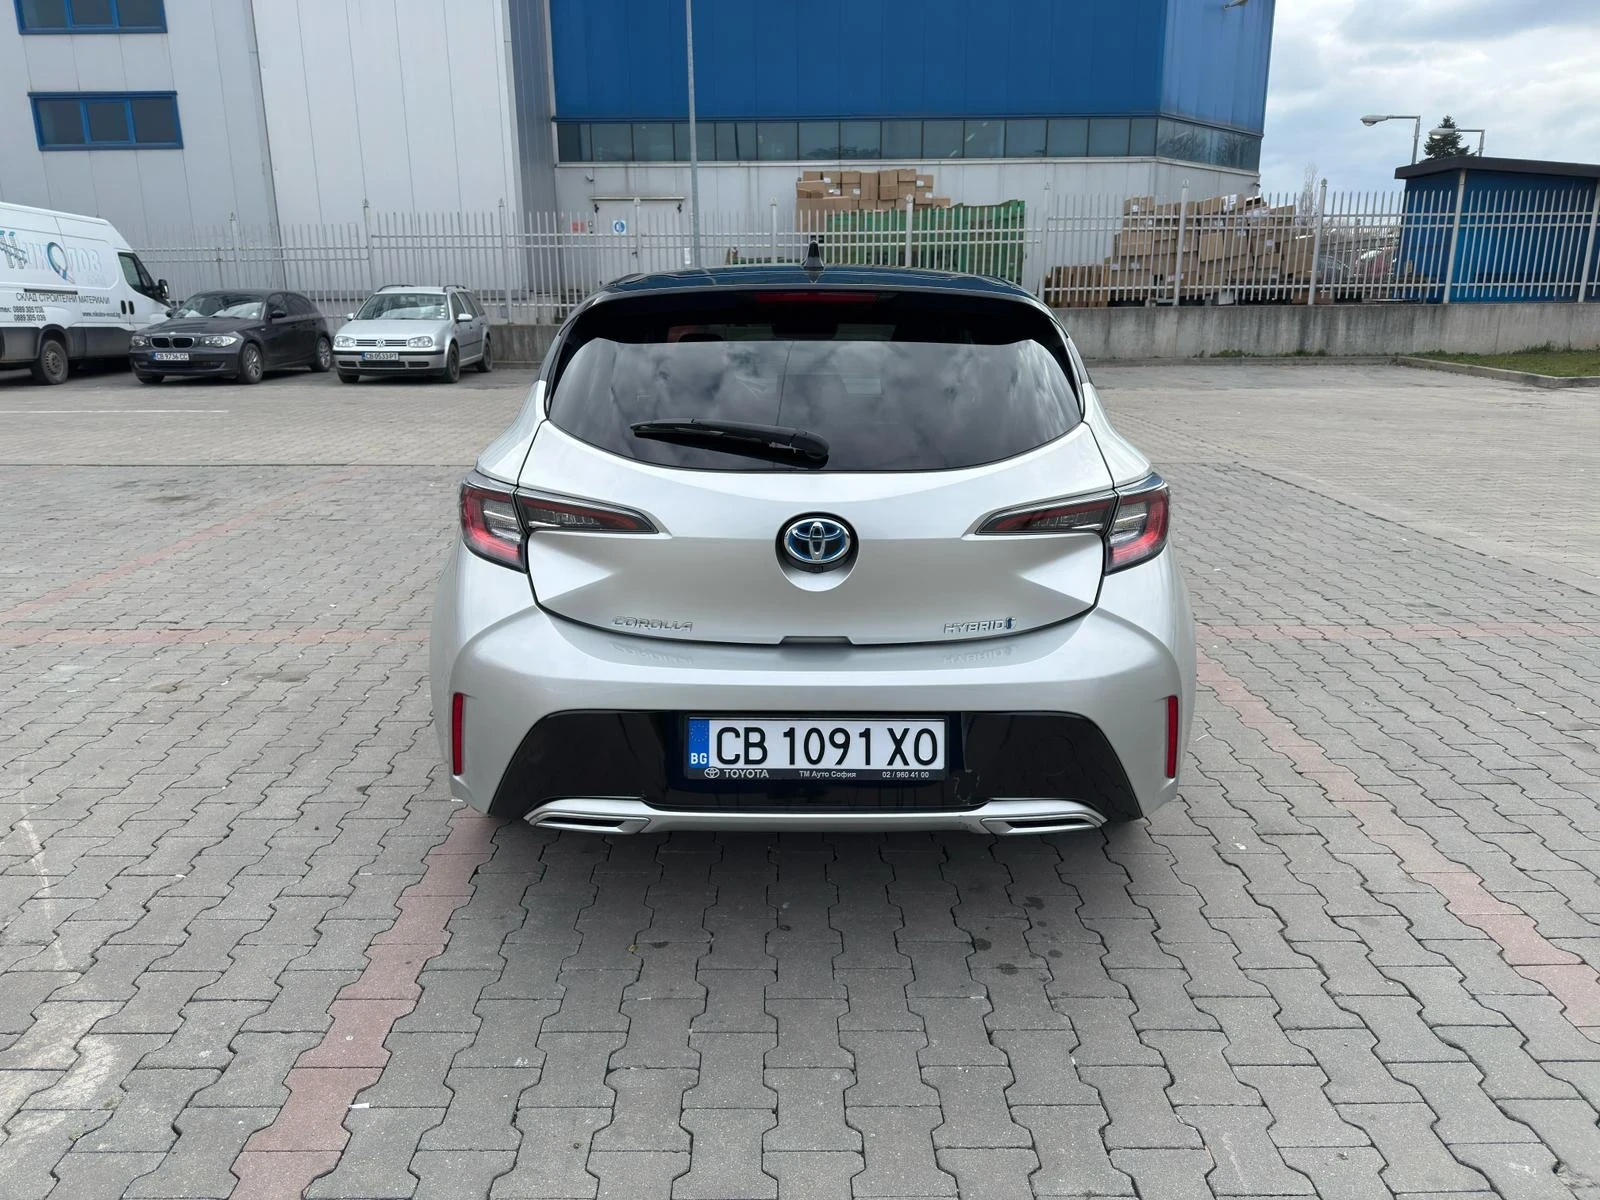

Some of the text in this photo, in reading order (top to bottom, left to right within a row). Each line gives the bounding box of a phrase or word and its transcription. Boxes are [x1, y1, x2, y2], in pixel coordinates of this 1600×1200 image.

[614, 616, 693, 632] COROLLA
[944, 619, 1005, 634] HYBRID
[716, 727, 938, 766] CB 1091 XO
[691, 753, 707, 764] BG
[724, 769, 769, 778] TOYOTA
[831, 771, 857, 779] София
